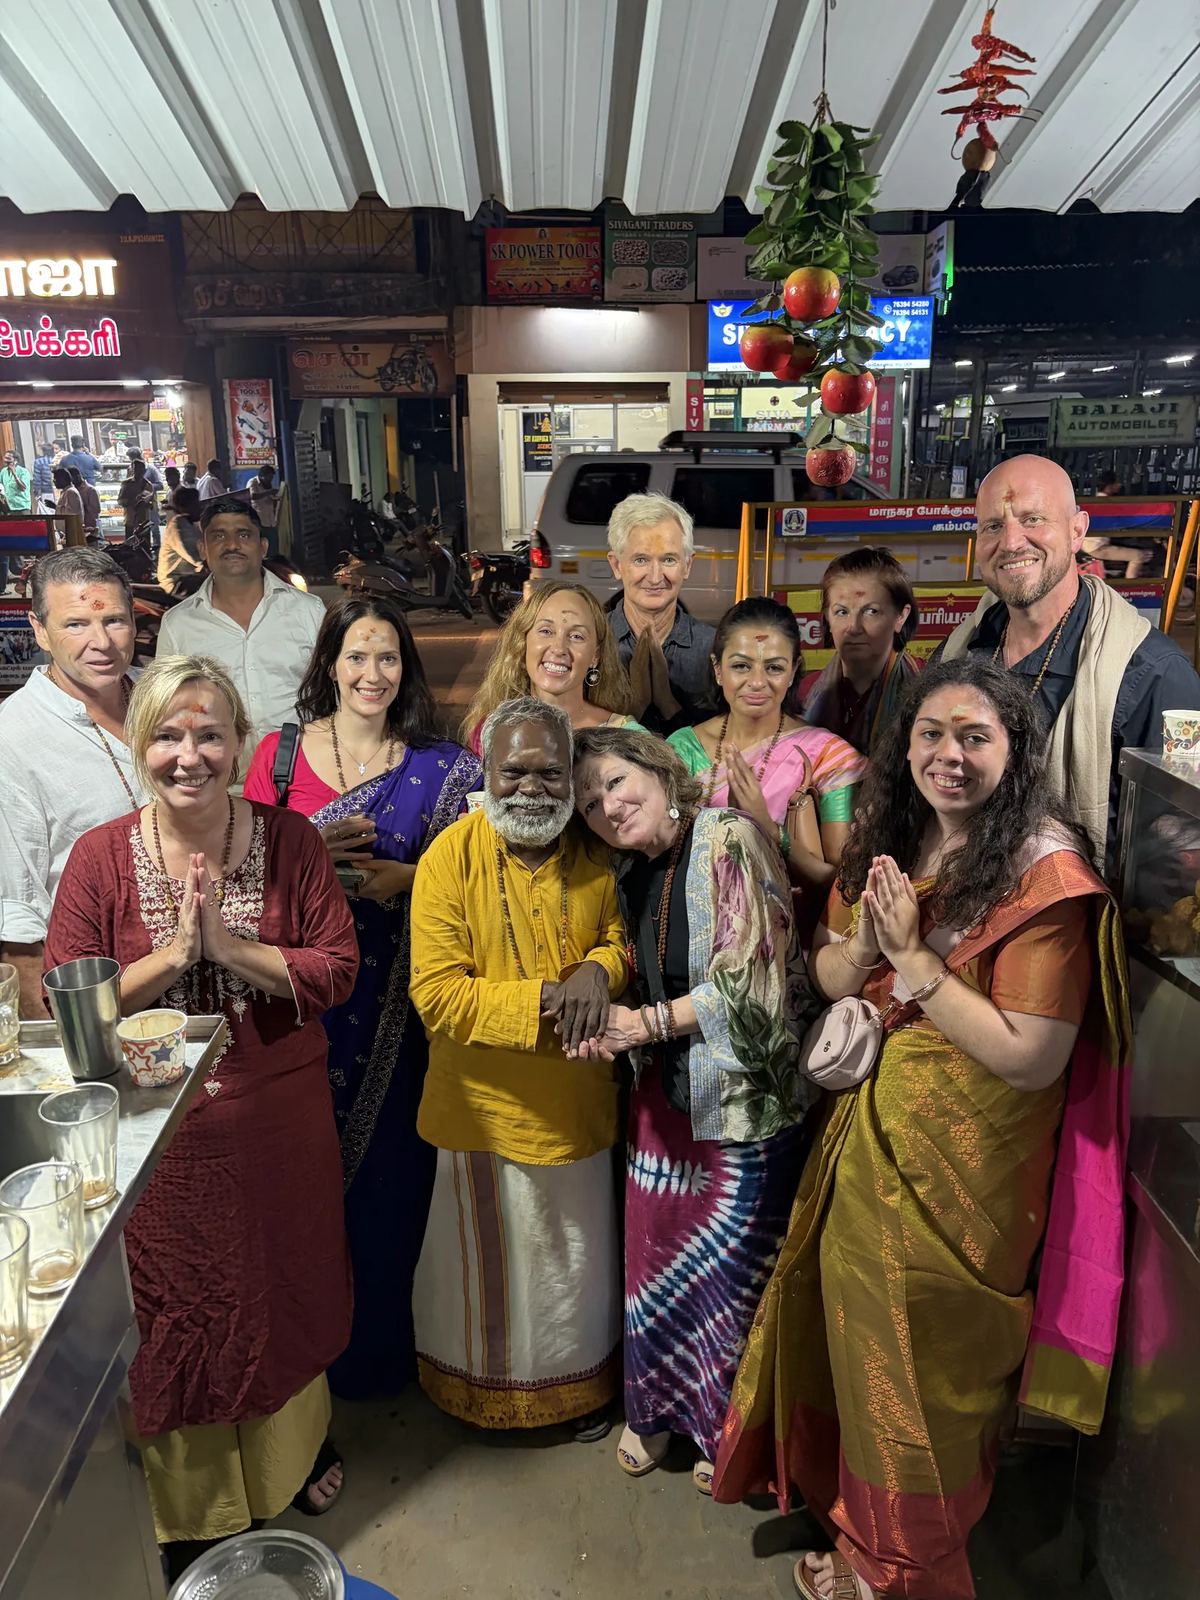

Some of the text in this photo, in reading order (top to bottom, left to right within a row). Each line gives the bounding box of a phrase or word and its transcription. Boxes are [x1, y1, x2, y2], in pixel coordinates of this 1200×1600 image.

[608, 220, 695, 231] SIVAGAMI TRADERS
[491, 242, 601, 260] SK POWER TOOLS
[690, 397, 699, 431] SIV
[756, 409, 794, 420] SIVA
[1070, 402, 1179, 416] BALAJI
[1066, 419, 1179, 431] AUTOMOBILES
[869, 507, 914, 518] மாநகர
